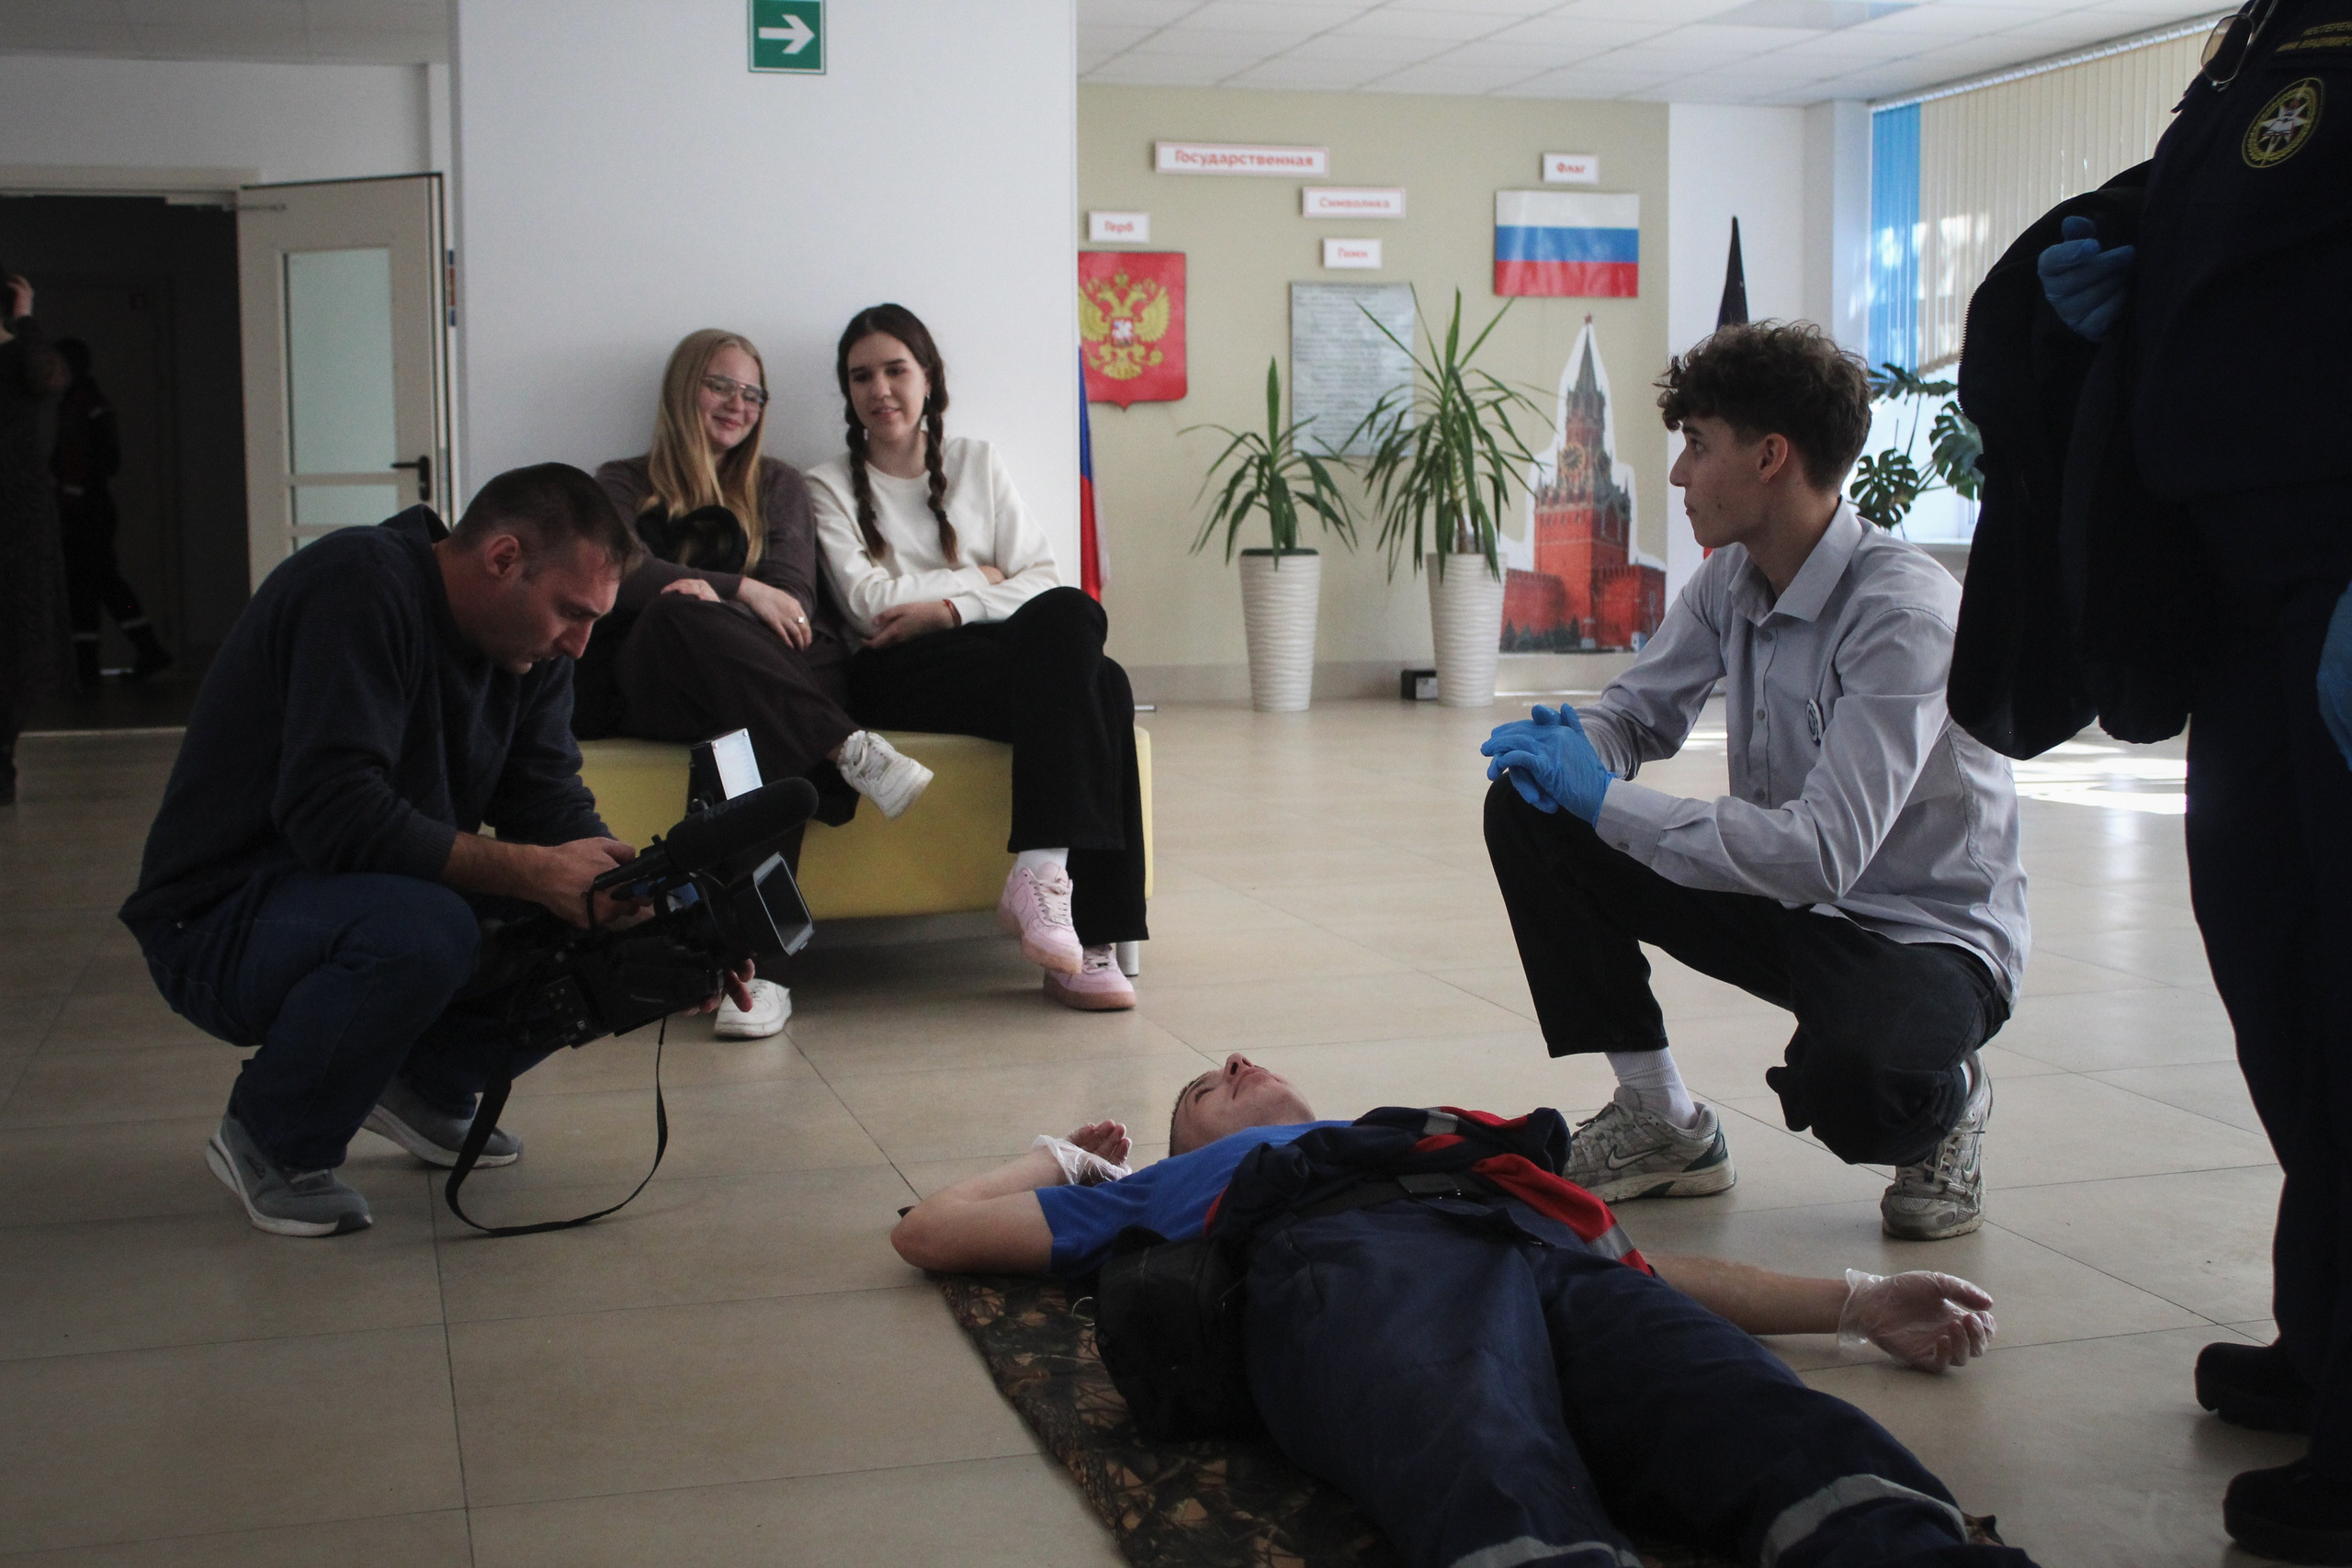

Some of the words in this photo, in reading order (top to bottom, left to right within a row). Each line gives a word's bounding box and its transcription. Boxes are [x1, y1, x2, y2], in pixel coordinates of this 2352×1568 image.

[1175, 150, 1314, 167] Государственная
[1556, 161, 1586, 175] Флаг
[1318, 197, 1390, 209] Символика
[1104, 220, 1135, 234] Герб
